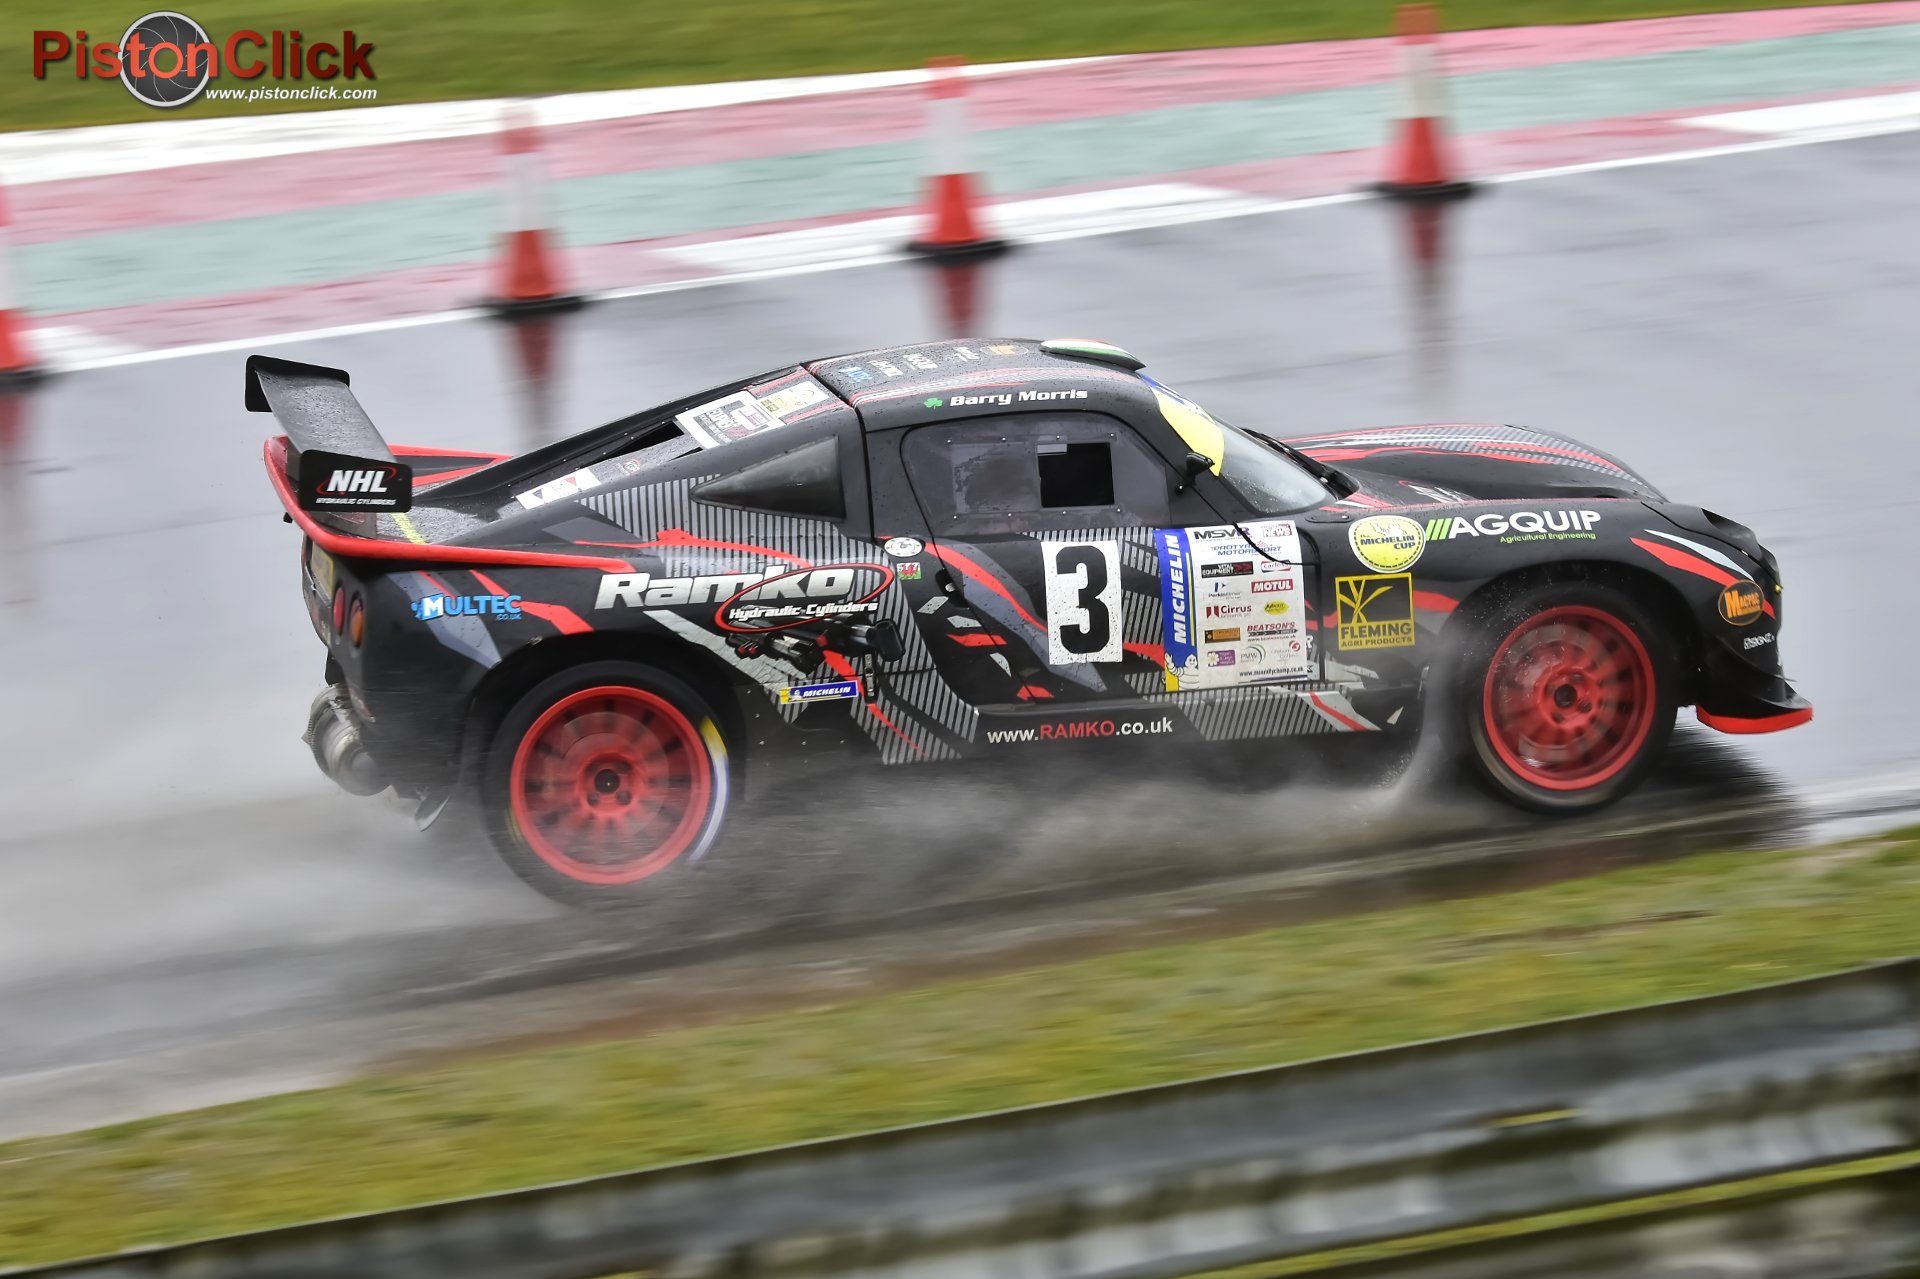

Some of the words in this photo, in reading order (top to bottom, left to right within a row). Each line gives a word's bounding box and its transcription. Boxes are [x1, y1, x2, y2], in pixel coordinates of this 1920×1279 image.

[949, 392, 1012, 407] Barry
[1018, 388, 1089, 403] Morris
[327, 469, 388, 493] NHL
[1449, 510, 1601, 539] AGQUIP
[1360, 535, 1416, 546] MICHELIN
[1393, 541, 1416, 550] CUP
[1500, 533, 1547, 544] Agricultural
[1548, 531, 1597, 541] Engineering
[594, 564, 855, 610] Ramko
[1164, 534, 1188, 645] MICHELIN
[1253, 580, 1292, 593] MOTUL
[422, 594, 523, 618] MULTEC
[1055, 545, 1110, 654] 3
[729, 604, 801, 622] Hydraulic
[805, 601, 879, 617] Cylinders
[1220, 604, 1252, 614] Cirrus
[1246, 621, 1296, 632] BEATSON'S
[1340, 623, 1412, 640] FLEMING
[1341, 639, 1363, 648] AGRI
[1364, 636, 1413, 647] PRODUCTS
[802, 685, 852, 698] MICHELIN
[986, 716, 1173, 744] www.RAMKO.co.uk
